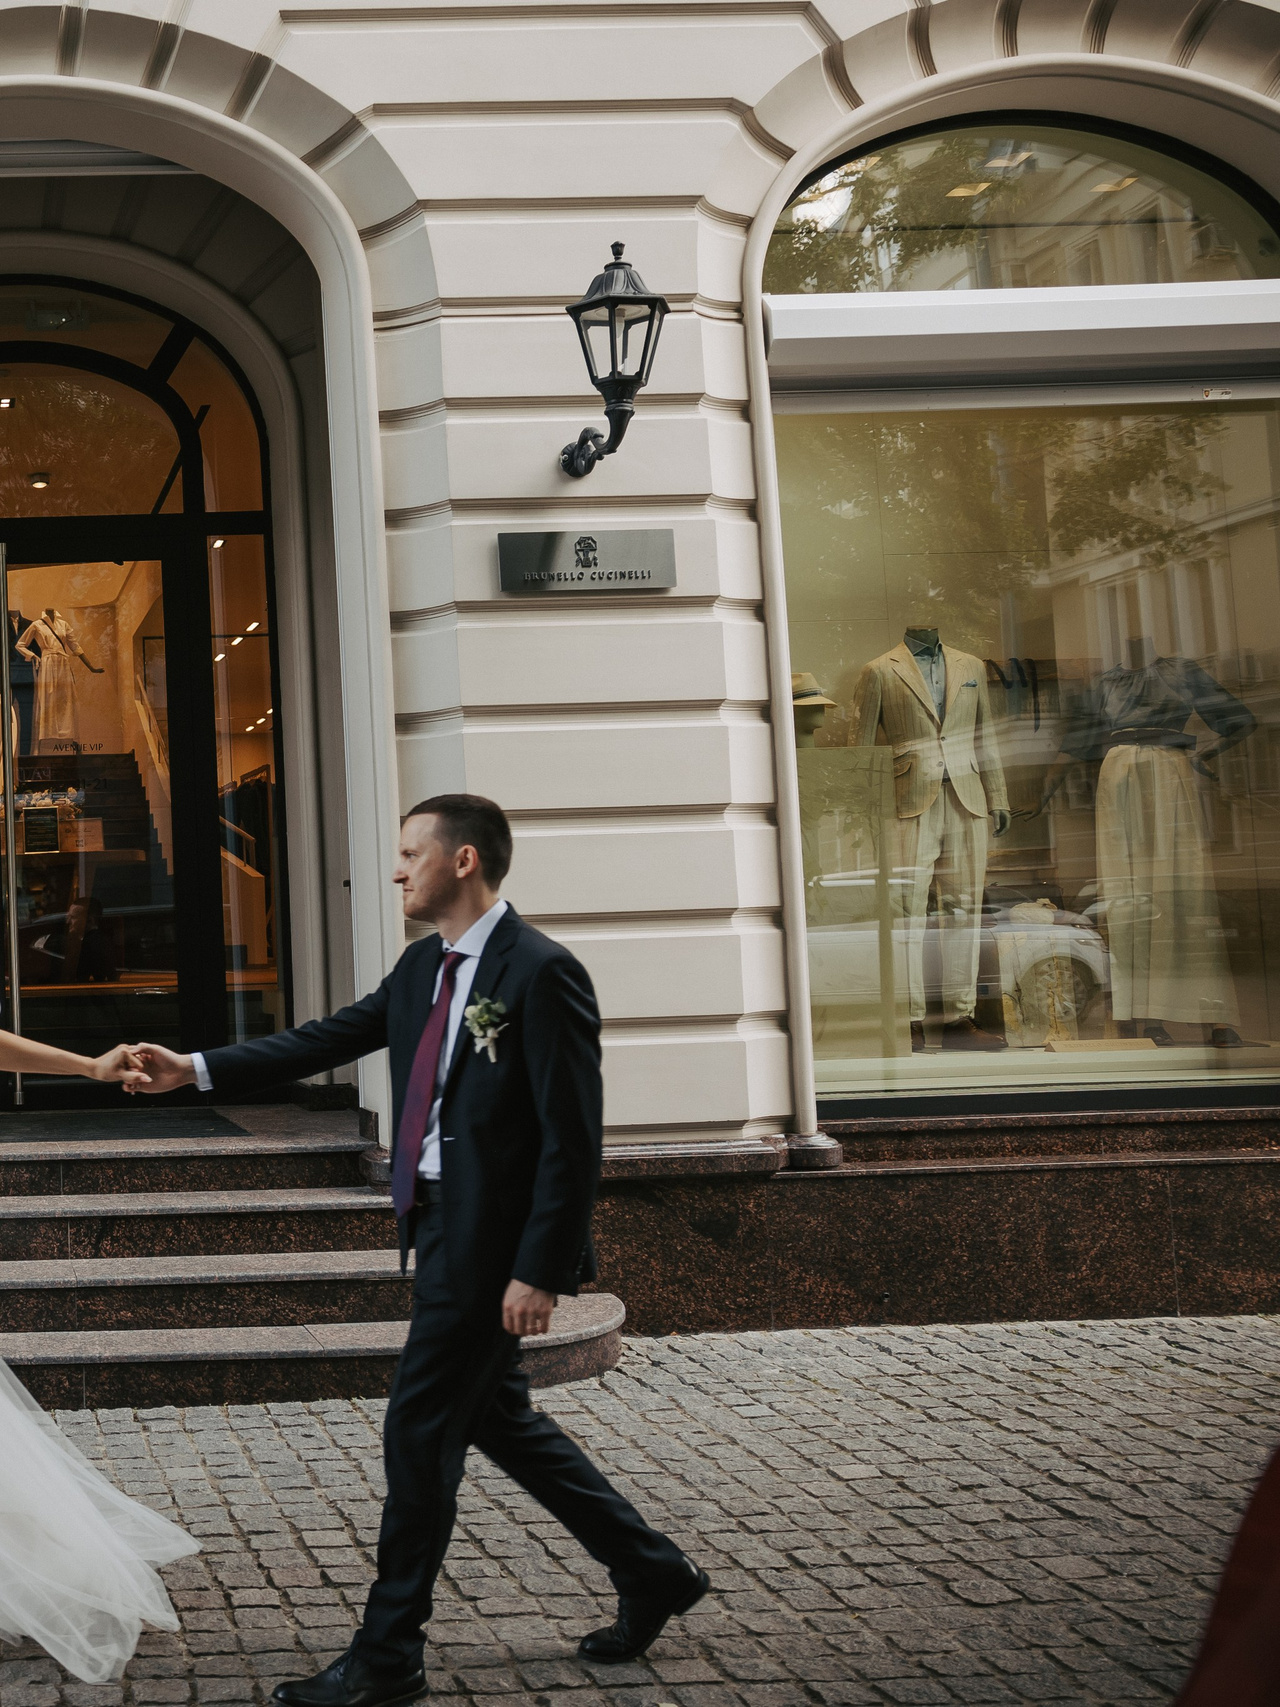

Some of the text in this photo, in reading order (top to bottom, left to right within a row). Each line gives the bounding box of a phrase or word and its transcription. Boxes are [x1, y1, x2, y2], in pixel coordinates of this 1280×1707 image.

[523, 570, 652, 583] BRUNELLO CUCINELLI
[52, 743, 104, 752] AVENUE VIP
